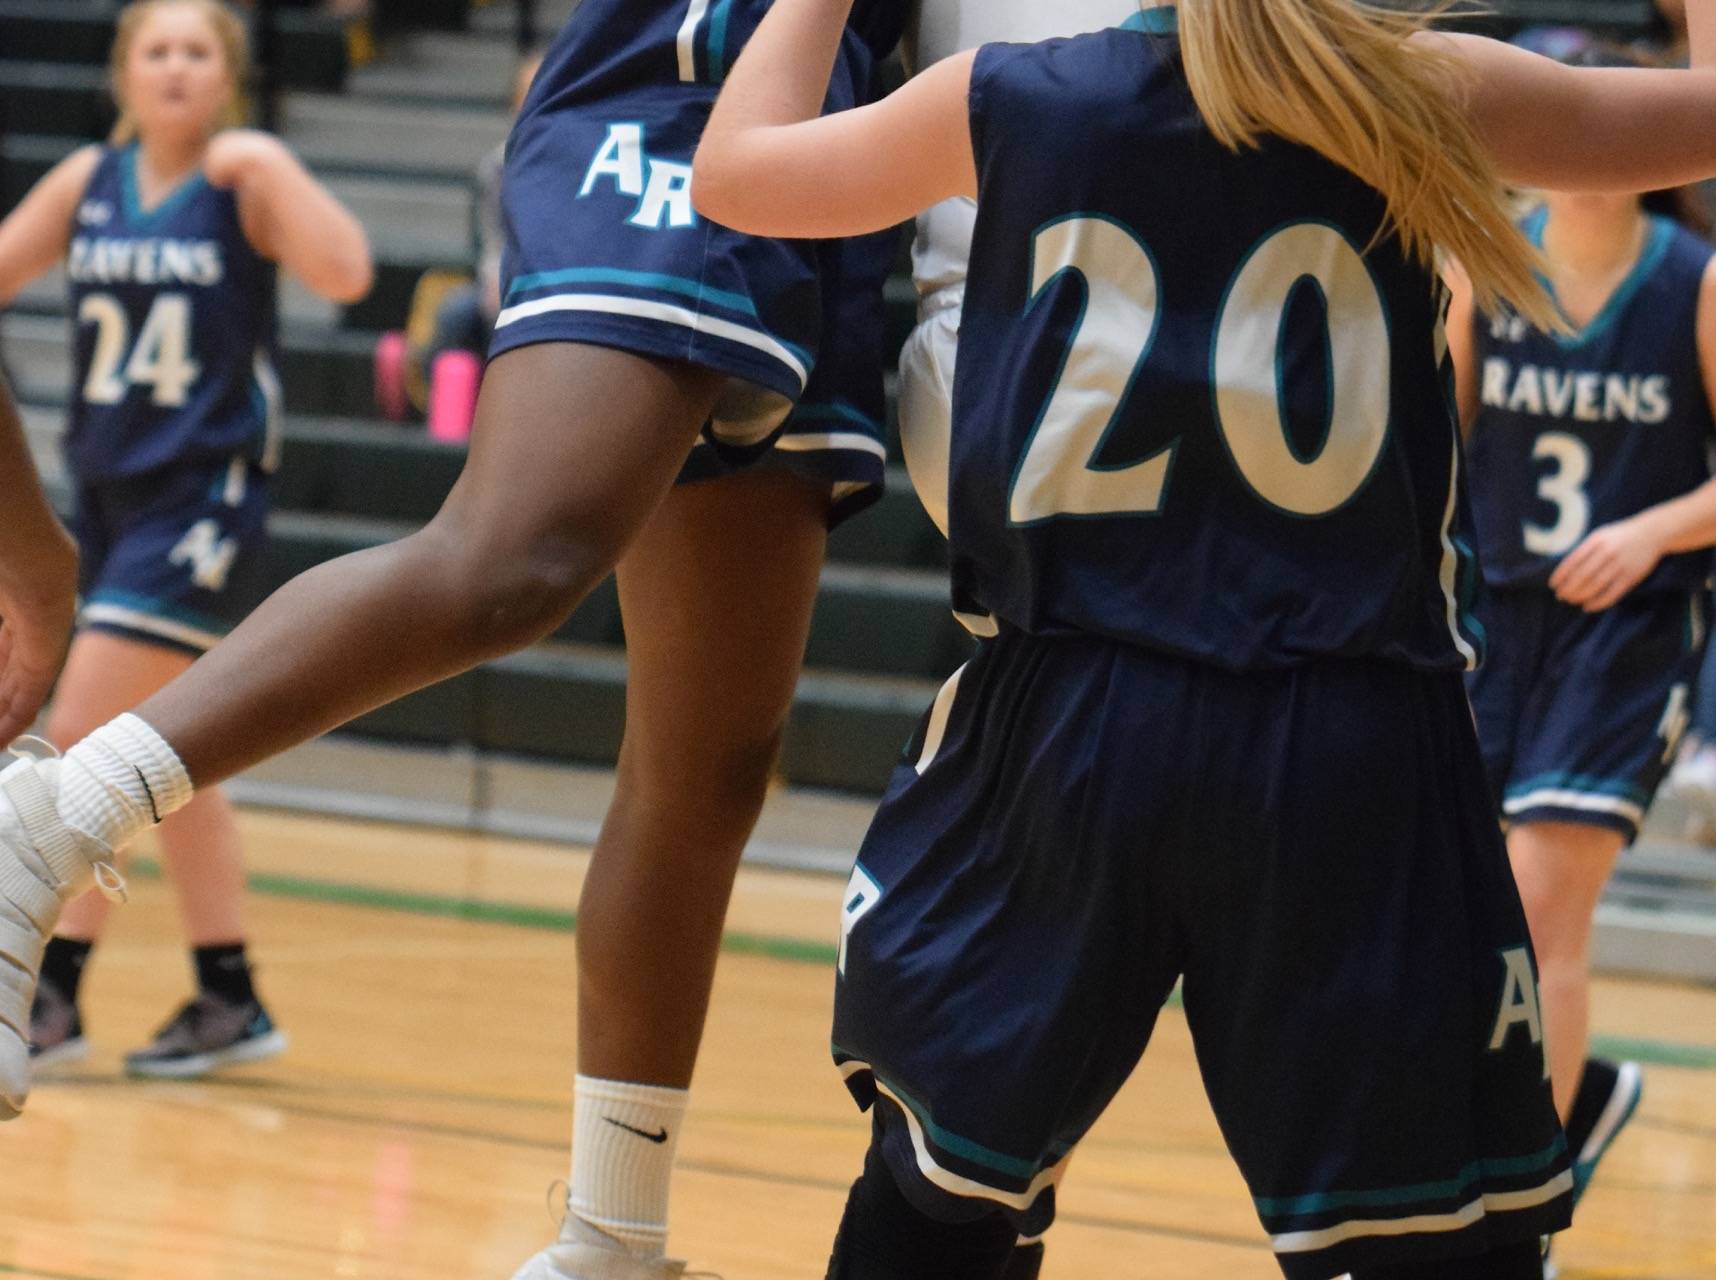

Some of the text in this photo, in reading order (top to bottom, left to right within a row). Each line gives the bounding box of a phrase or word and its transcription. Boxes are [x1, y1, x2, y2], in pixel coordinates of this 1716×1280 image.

[576, 121, 696, 229] AR
[78, 292, 200, 407] 24
[1006, 211, 1393, 527] 20
[1482, 356, 1672, 424] RAVENS
[1521, 432, 1592, 558] 3
